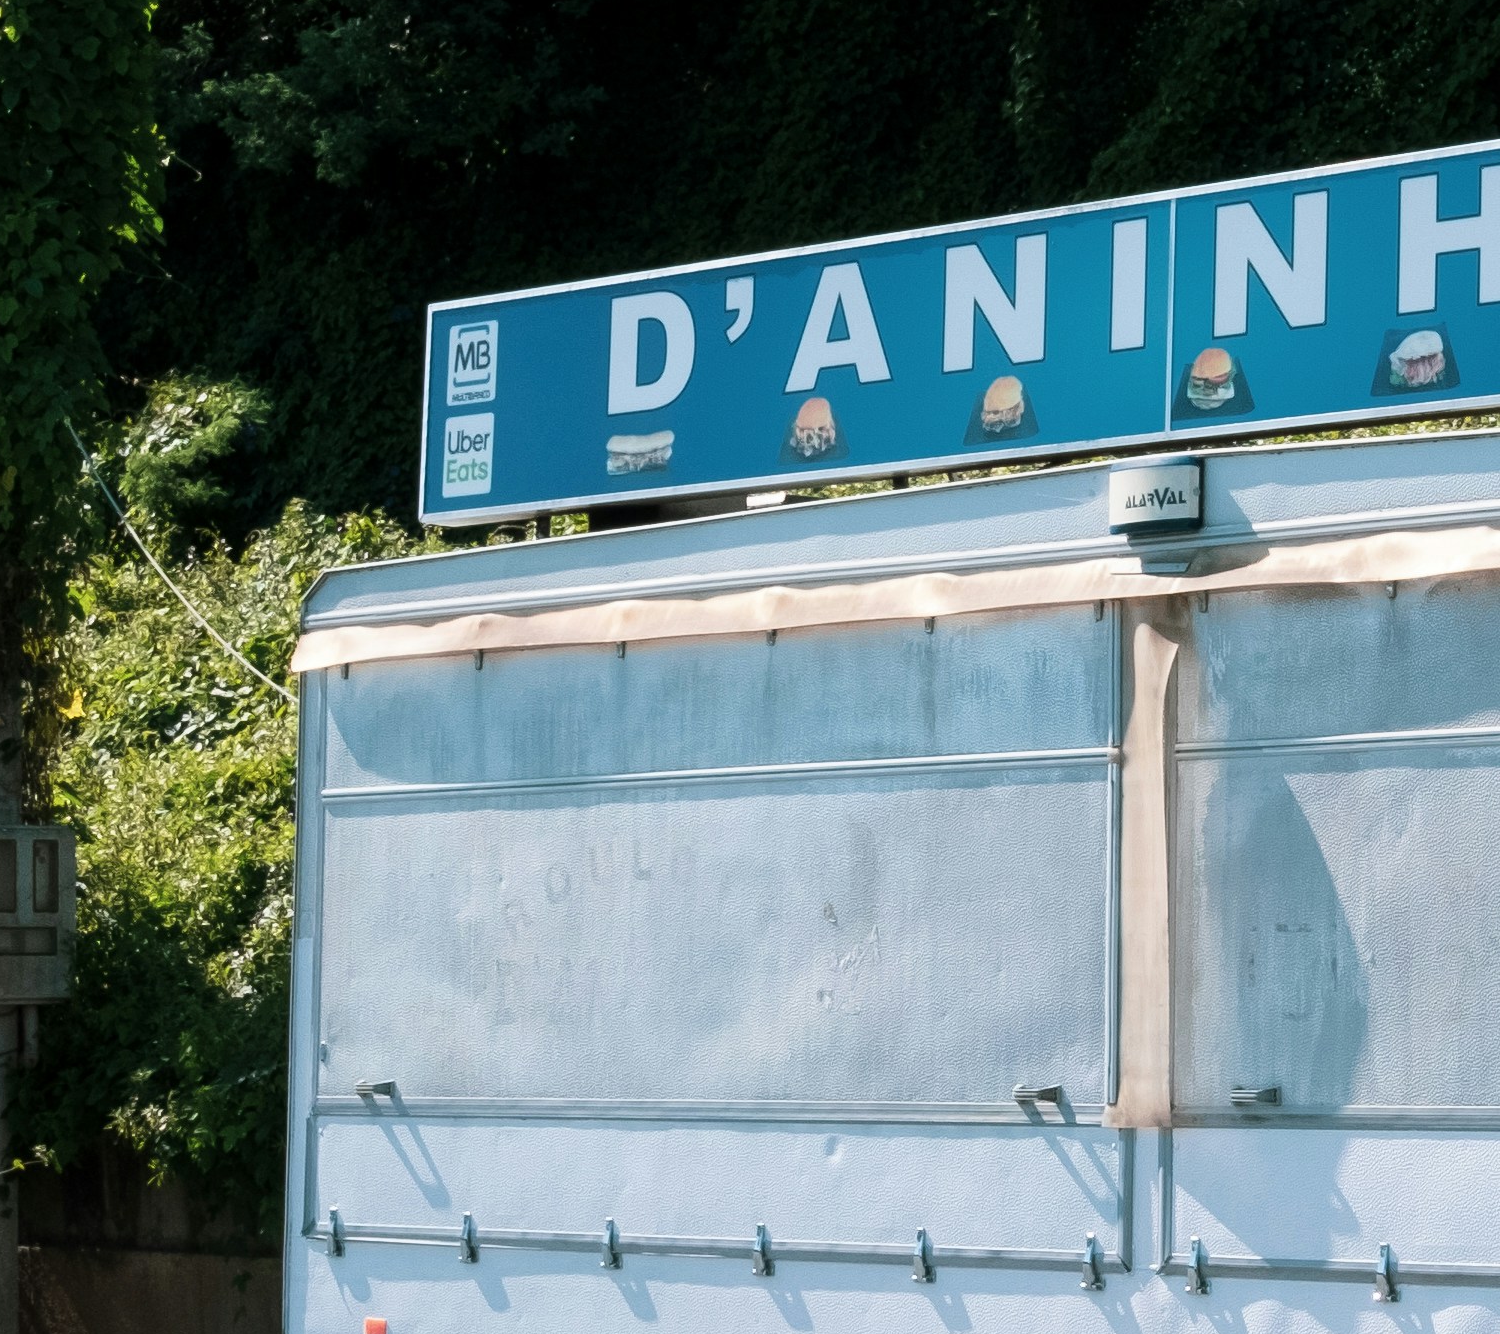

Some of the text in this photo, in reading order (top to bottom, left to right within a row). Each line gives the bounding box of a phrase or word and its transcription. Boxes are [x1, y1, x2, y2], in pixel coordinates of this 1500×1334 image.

[454, 340, 490, 373] MB
[448, 429, 490, 455] Uber
[446, 458, 488, 483] Eats
